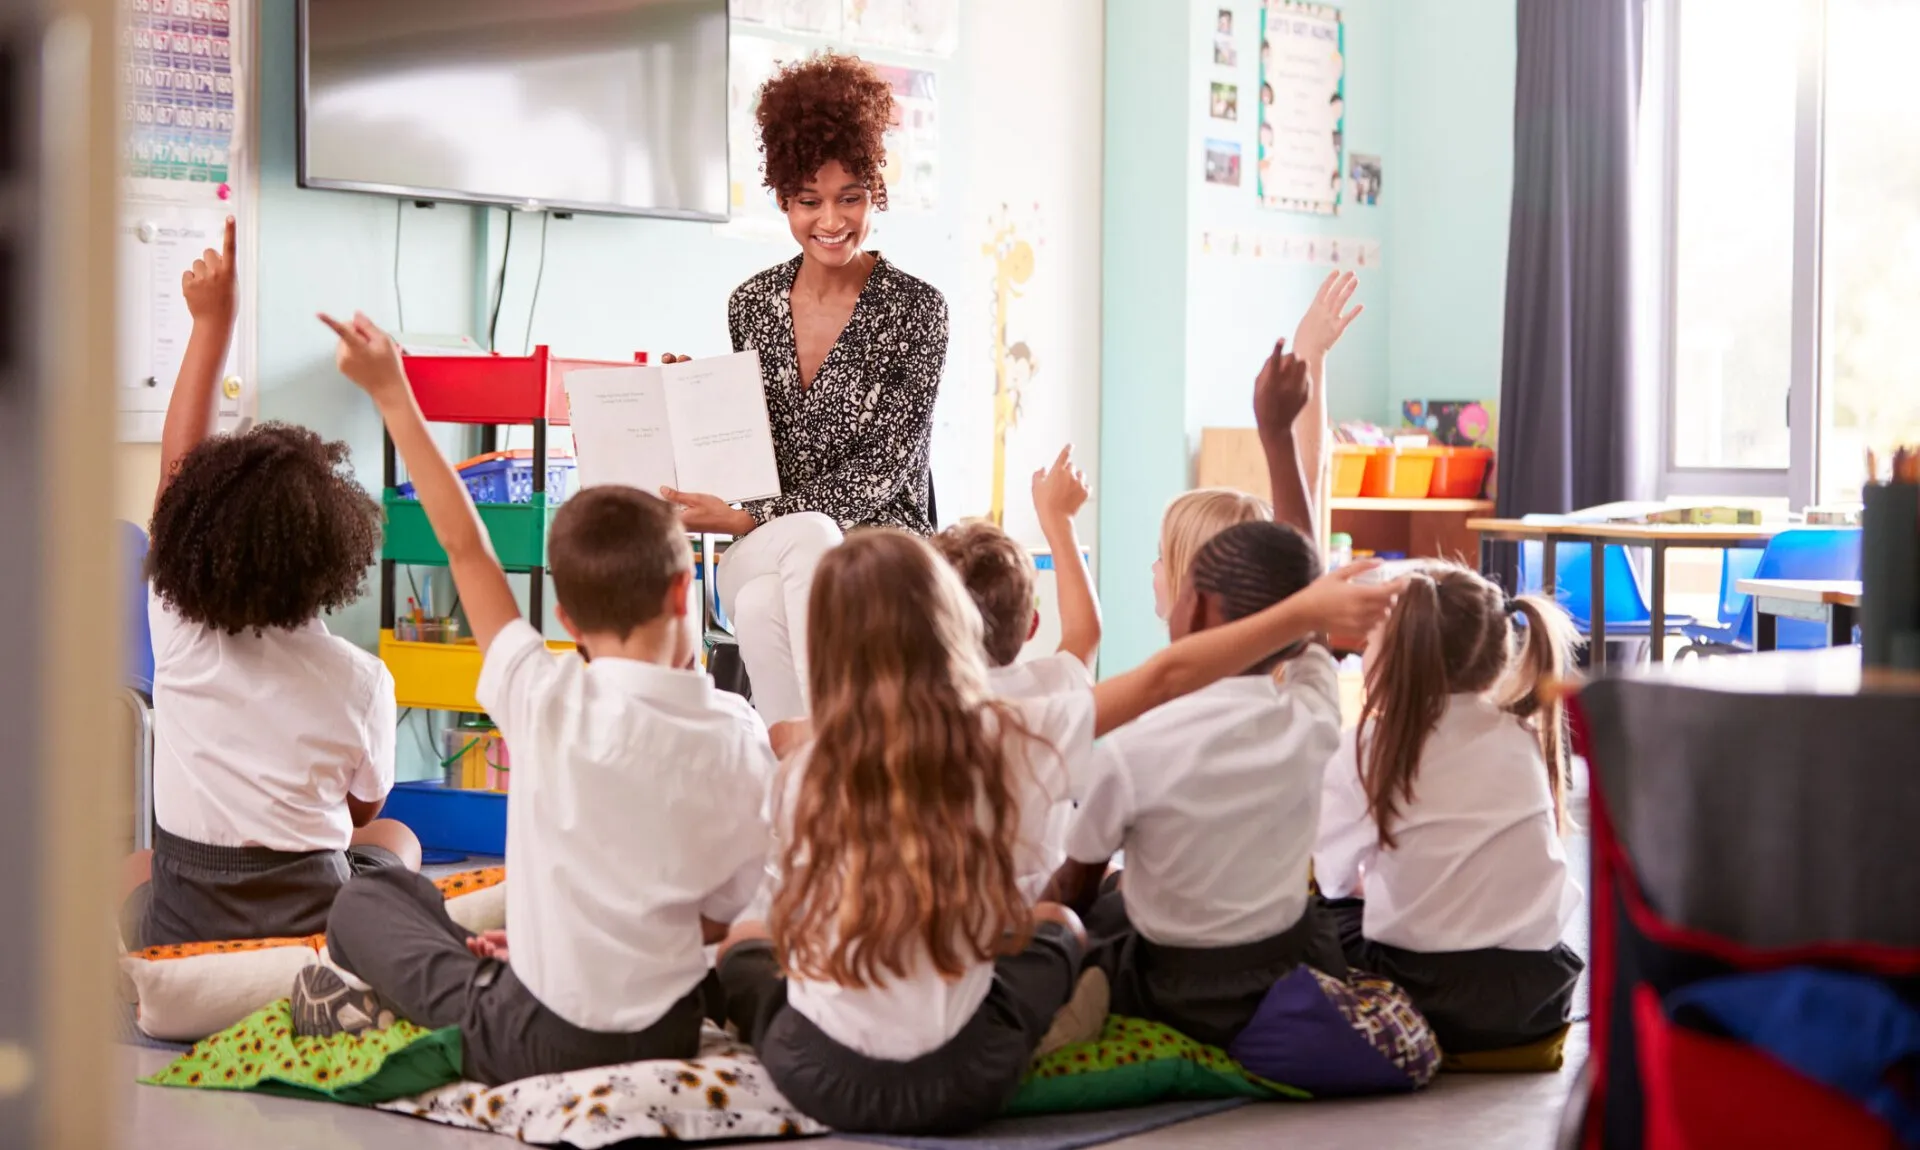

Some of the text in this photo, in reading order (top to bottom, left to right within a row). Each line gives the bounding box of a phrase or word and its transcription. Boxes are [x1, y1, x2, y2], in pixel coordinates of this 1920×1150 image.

[133, 32, 150, 48] 166
[153, 34, 170, 51] 167
[173, 36, 190, 53] 168
[192, 38, 210, 56] 169
[135, 69, 152, 86] 176
[155, 71, 172, 87] 177
[175, 72, 193, 89] 178
[195, 74, 213, 92] 179
[136, 105, 152, 122] 186
[156, 107, 173, 123] 187
[176, 109, 192, 126] 188
[196, 111, 213, 128] 189
